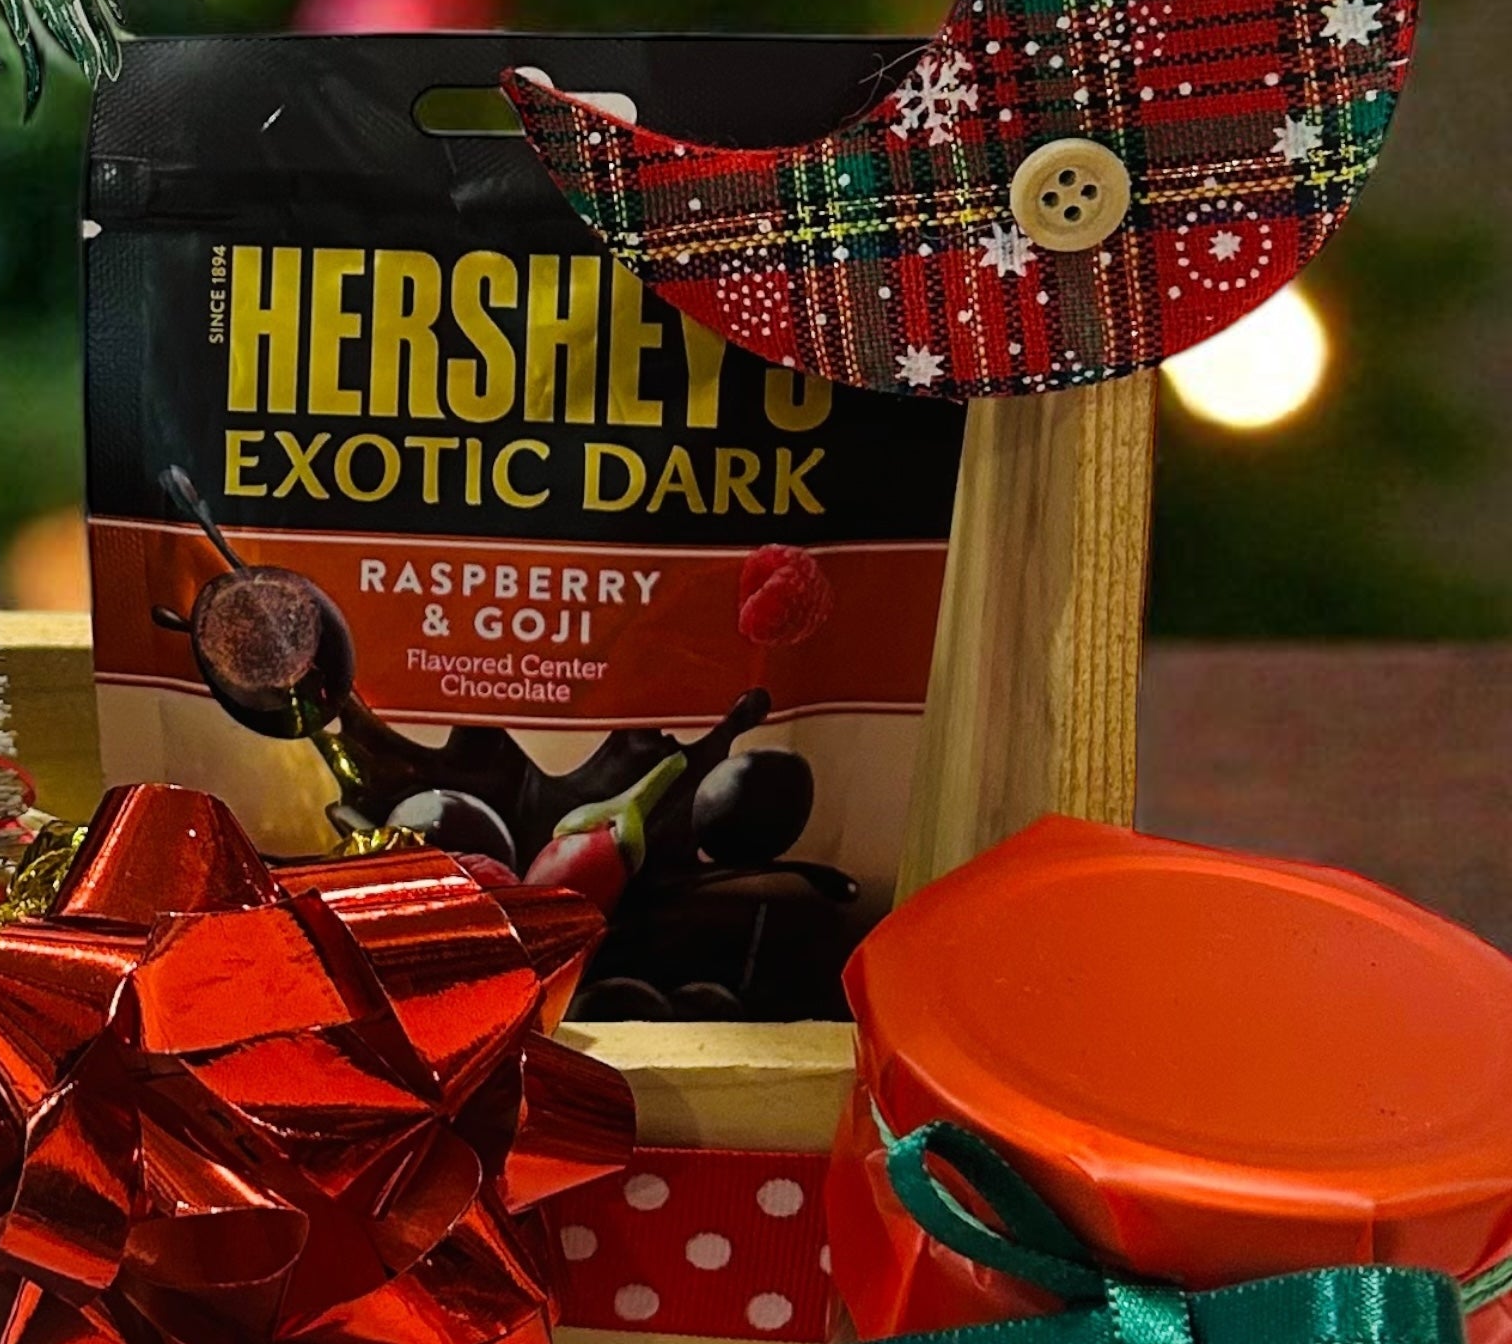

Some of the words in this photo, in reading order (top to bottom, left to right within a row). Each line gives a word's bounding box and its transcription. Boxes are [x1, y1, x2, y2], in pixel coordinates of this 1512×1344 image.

[210, 244, 228, 285] 1894
[208, 288, 226, 345] SINCE
[227, 245, 833, 432] HERSHEY
[223, 429, 552, 509] EXOTIC
[582, 441, 827, 516] DARK
[359, 558, 662, 606] RASPBERRY
[421, 603, 451, 637] &
[473, 606, 591, 644] GOJI
[406, 648, 514, 676] Flavored
[520, 654, 609, 680] Center
[440, 674, 572, 703] Chocolate
